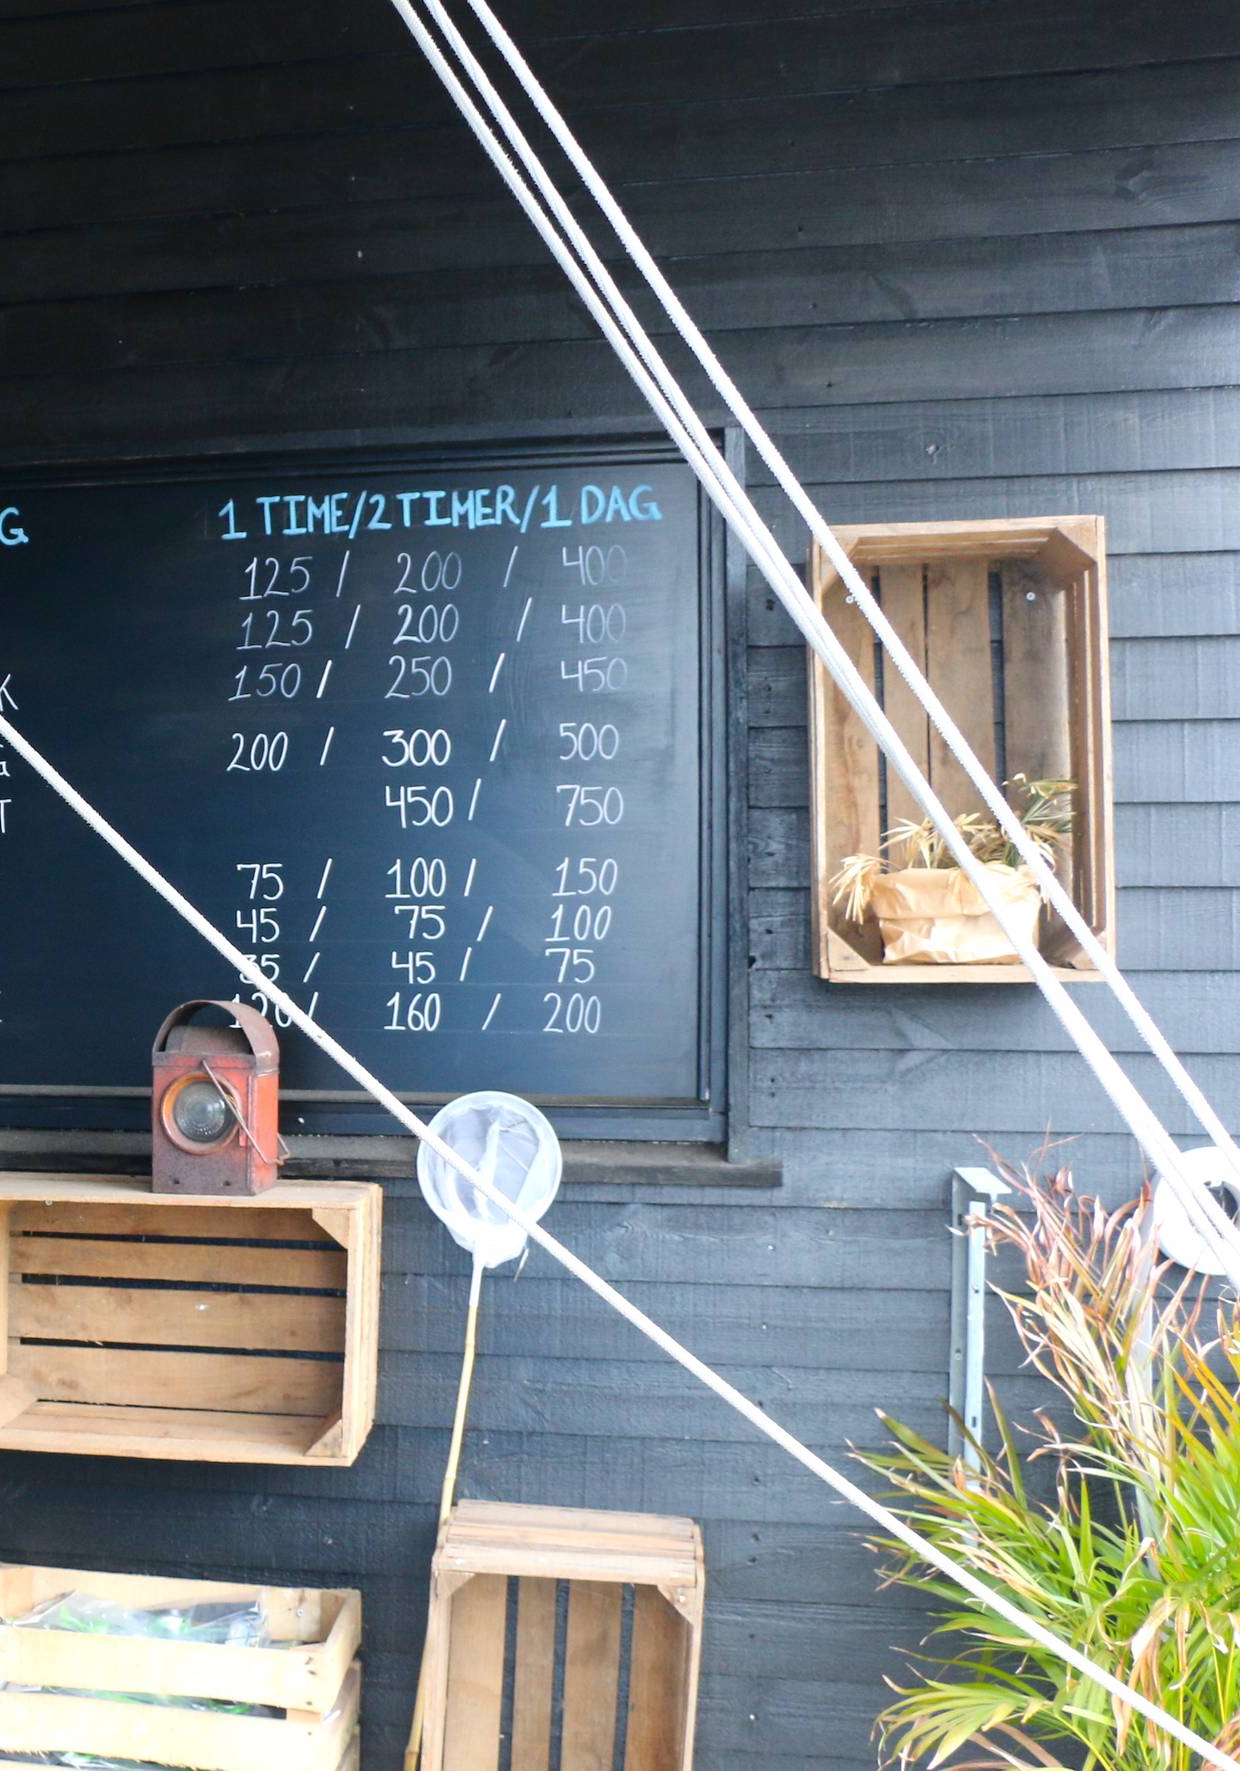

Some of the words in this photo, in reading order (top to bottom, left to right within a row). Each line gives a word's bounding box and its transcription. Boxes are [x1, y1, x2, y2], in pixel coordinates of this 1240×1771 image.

[219, 498, 247, 540] 1
[580, 484, 663, 525] DAG
[239, 555, 313, 600] 125
[394, 550, 462, 594] 200
[562, 544, 628, 586] 400
[236, 609, 313, 650] 125
[393, 603, 460, 645] 200
[561, 602, 626, 644] 400
[228, 662, 301, 700] 150
[384, 655, 452, 699] 250
[560, 656, 628, 693] 450
[226, 731, 289, 772] 200
[381, 728, 451, 767] 300
[558, 721, 620, 761] 500
[384, 784, 454, 829] 450
[556, 784, 624, 827] 750
[236, 862, 285, 901] 75
[385, 856, 447, 900] 100
[551, 856, 618, 897] 150
[236, 905, 281, 943] 45
[394, 904, 446, 940] 75
[544, 903, 612, 943] 100
[391, 950, 436, 984] 45
[544, 948, 596, 984] 75
[383, 991, 441, 1032] 160
[543, 993, 602, 1033] 200
